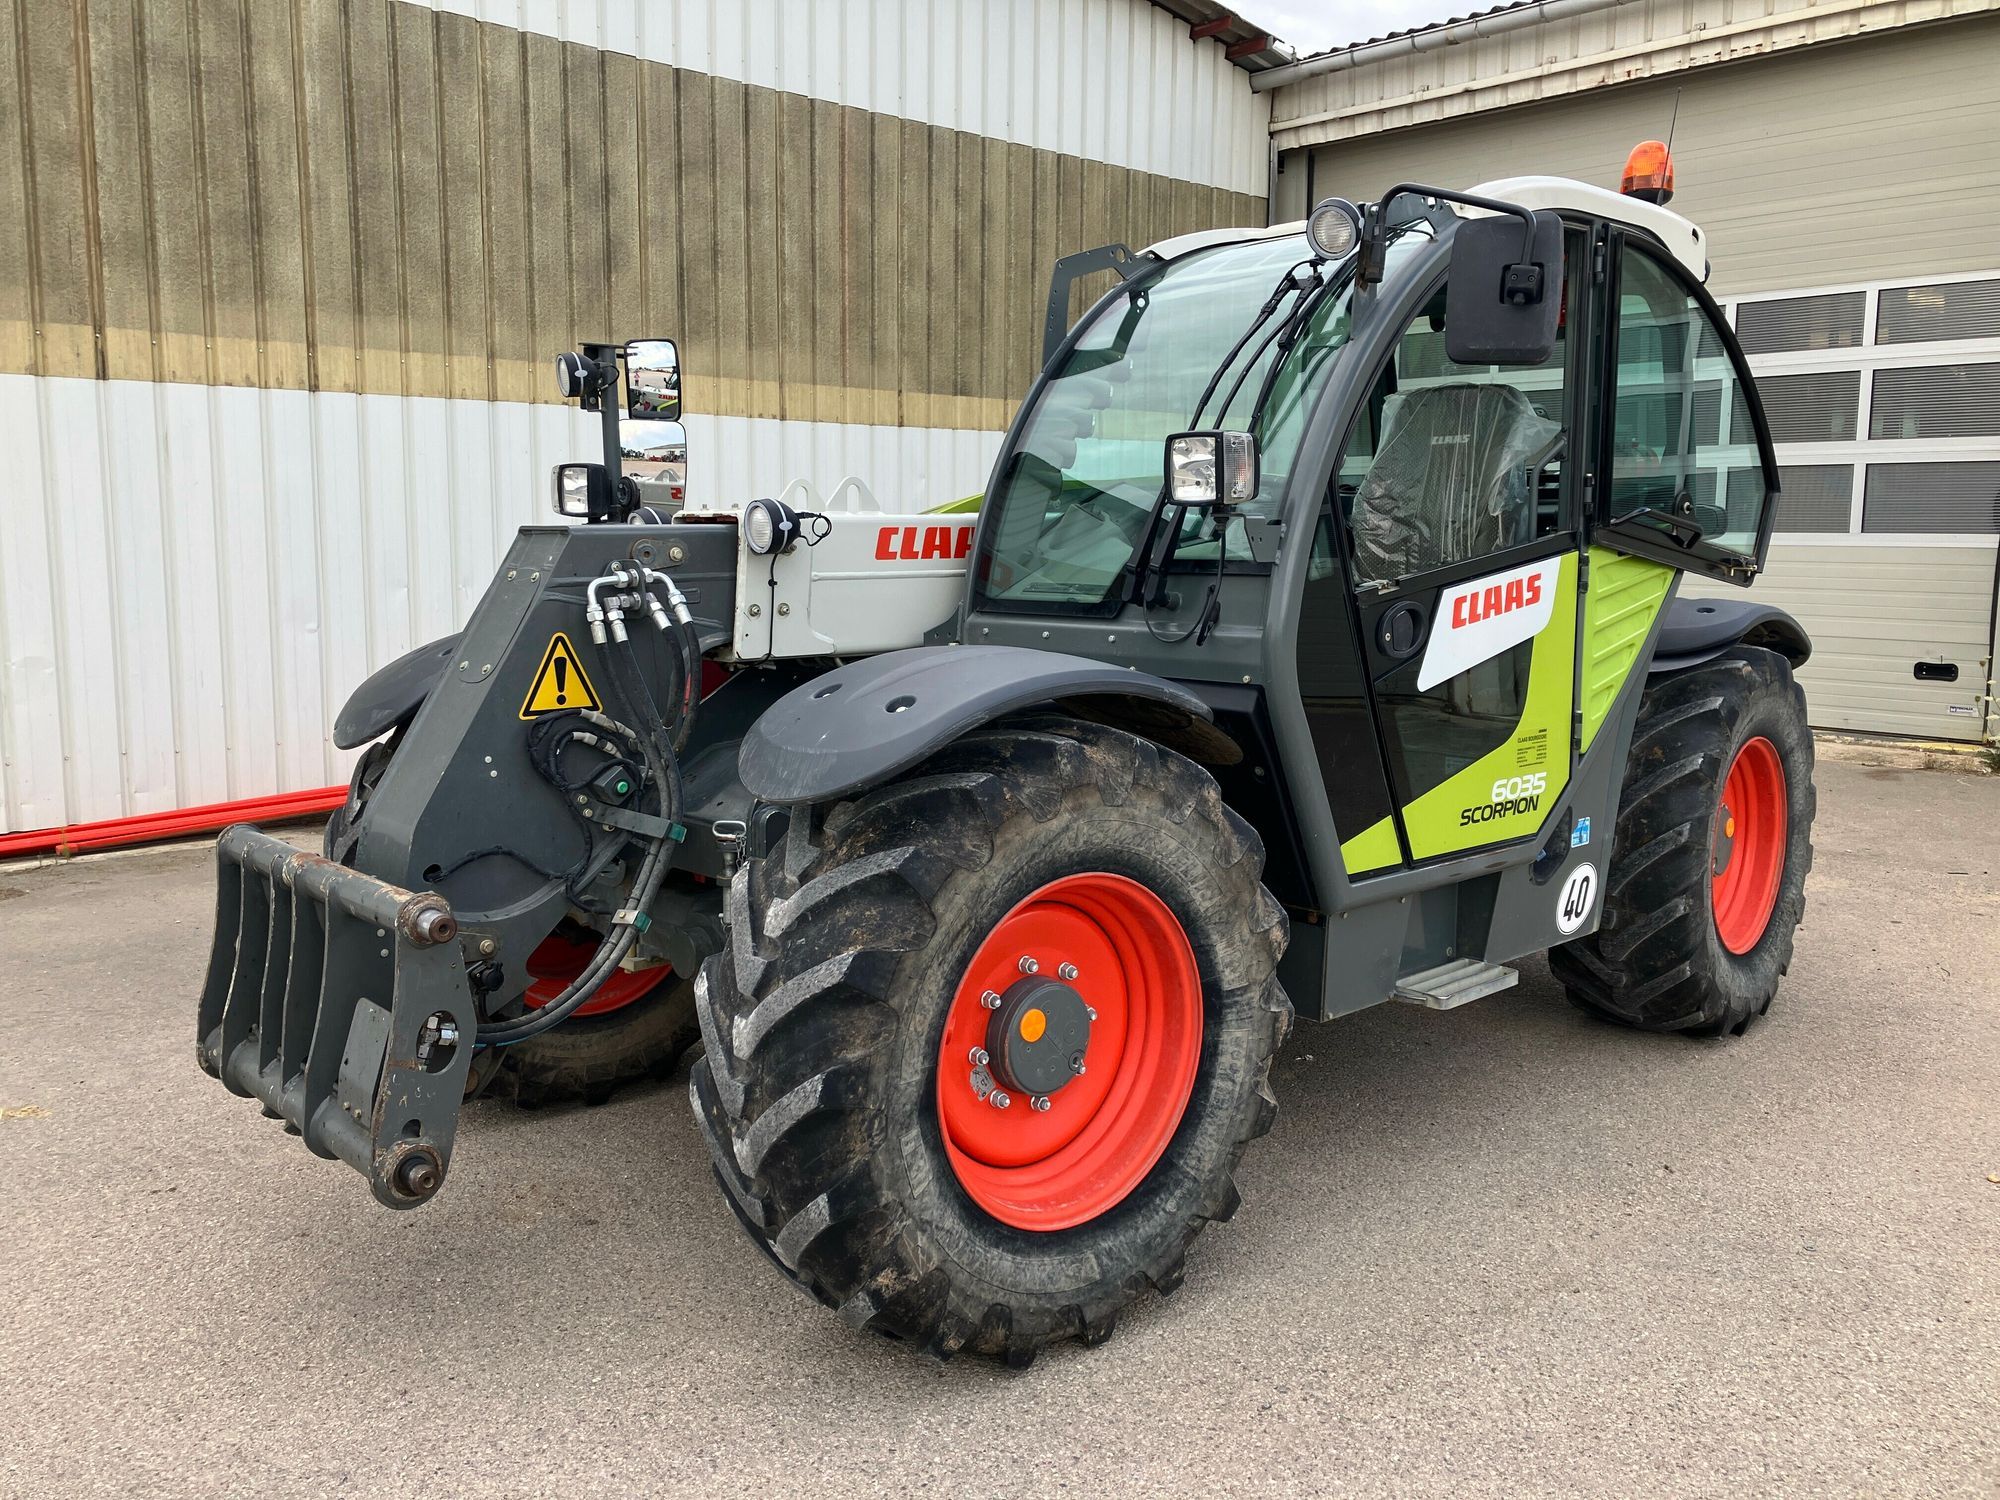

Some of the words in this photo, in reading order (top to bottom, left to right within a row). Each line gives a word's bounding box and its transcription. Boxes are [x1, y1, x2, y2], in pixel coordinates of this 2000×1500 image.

[1431, 434, 1471, 445] CLAAS
[1452, 573, 1541, 629] CLAAS
[1491, 772, 1547, 803] 6035
[1460, 795, 1539, 826] SCORPION
[1563, 875, 1590, 921] 40
